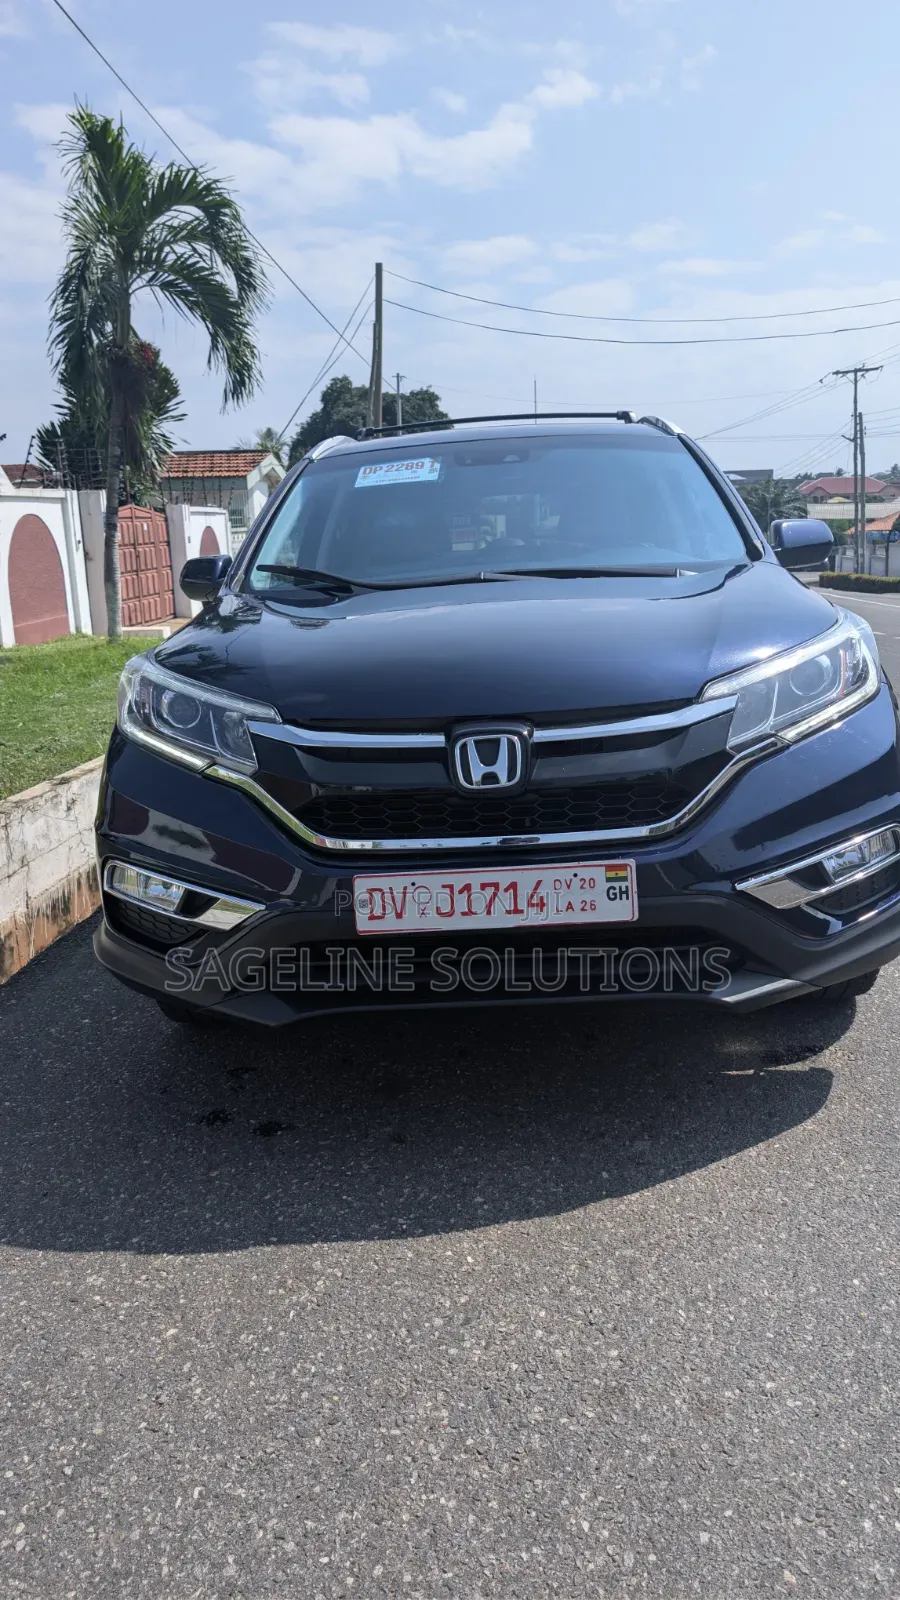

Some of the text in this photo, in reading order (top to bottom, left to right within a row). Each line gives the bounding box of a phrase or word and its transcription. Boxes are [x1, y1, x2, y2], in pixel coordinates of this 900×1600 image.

[384, 461, 425, 473] 2289
[553, 877, 596, 890] DV 20
[606, 885, 629, 901] GH
[366, 880, 546, 920] DV J1714
[555, 899, 597, 912] LA 26
